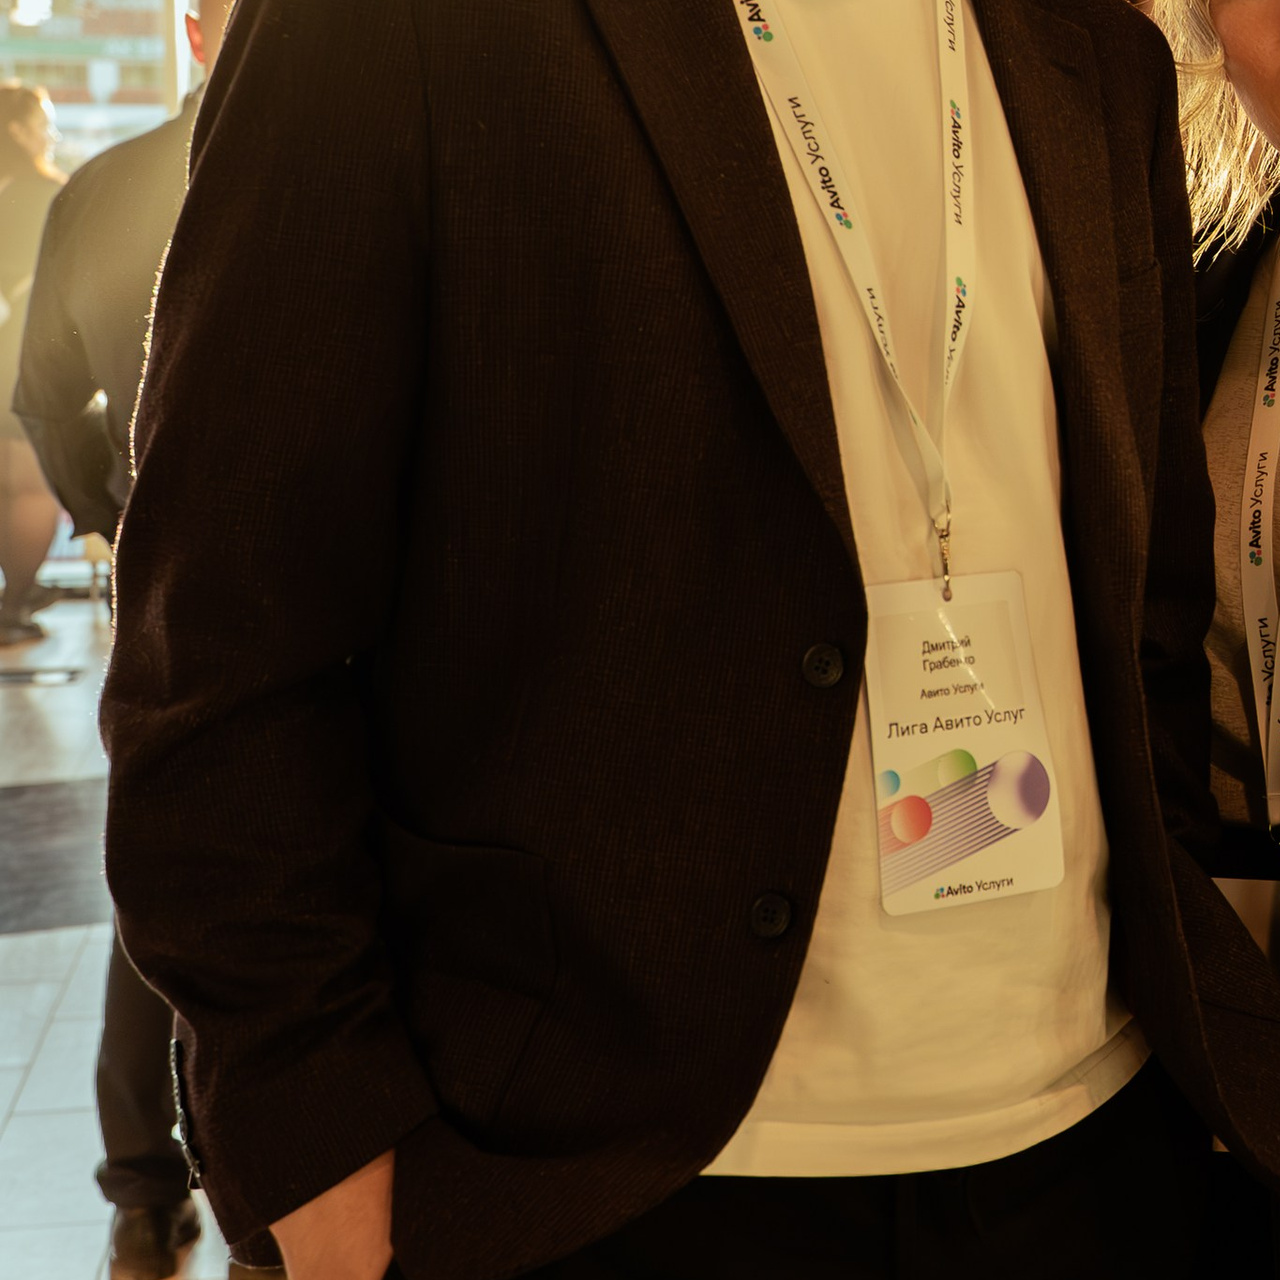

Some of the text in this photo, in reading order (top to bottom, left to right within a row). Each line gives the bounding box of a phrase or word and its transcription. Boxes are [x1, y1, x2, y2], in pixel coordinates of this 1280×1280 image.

[787, 96, 844, 211] Avito Услуги
[949, 117, 963, 225] Avito Услуги
[950, 294, 966, 342] Avito
[1264, 356, 1279, 392] Avito
[1248, 451, 1269, 550] Avito Услуги
[920, 686, 950, 699] Авито
[888, 708, 1025, 739] Лига Авито Услуг
[946, 876, 1014, 898] Avito Услуги
